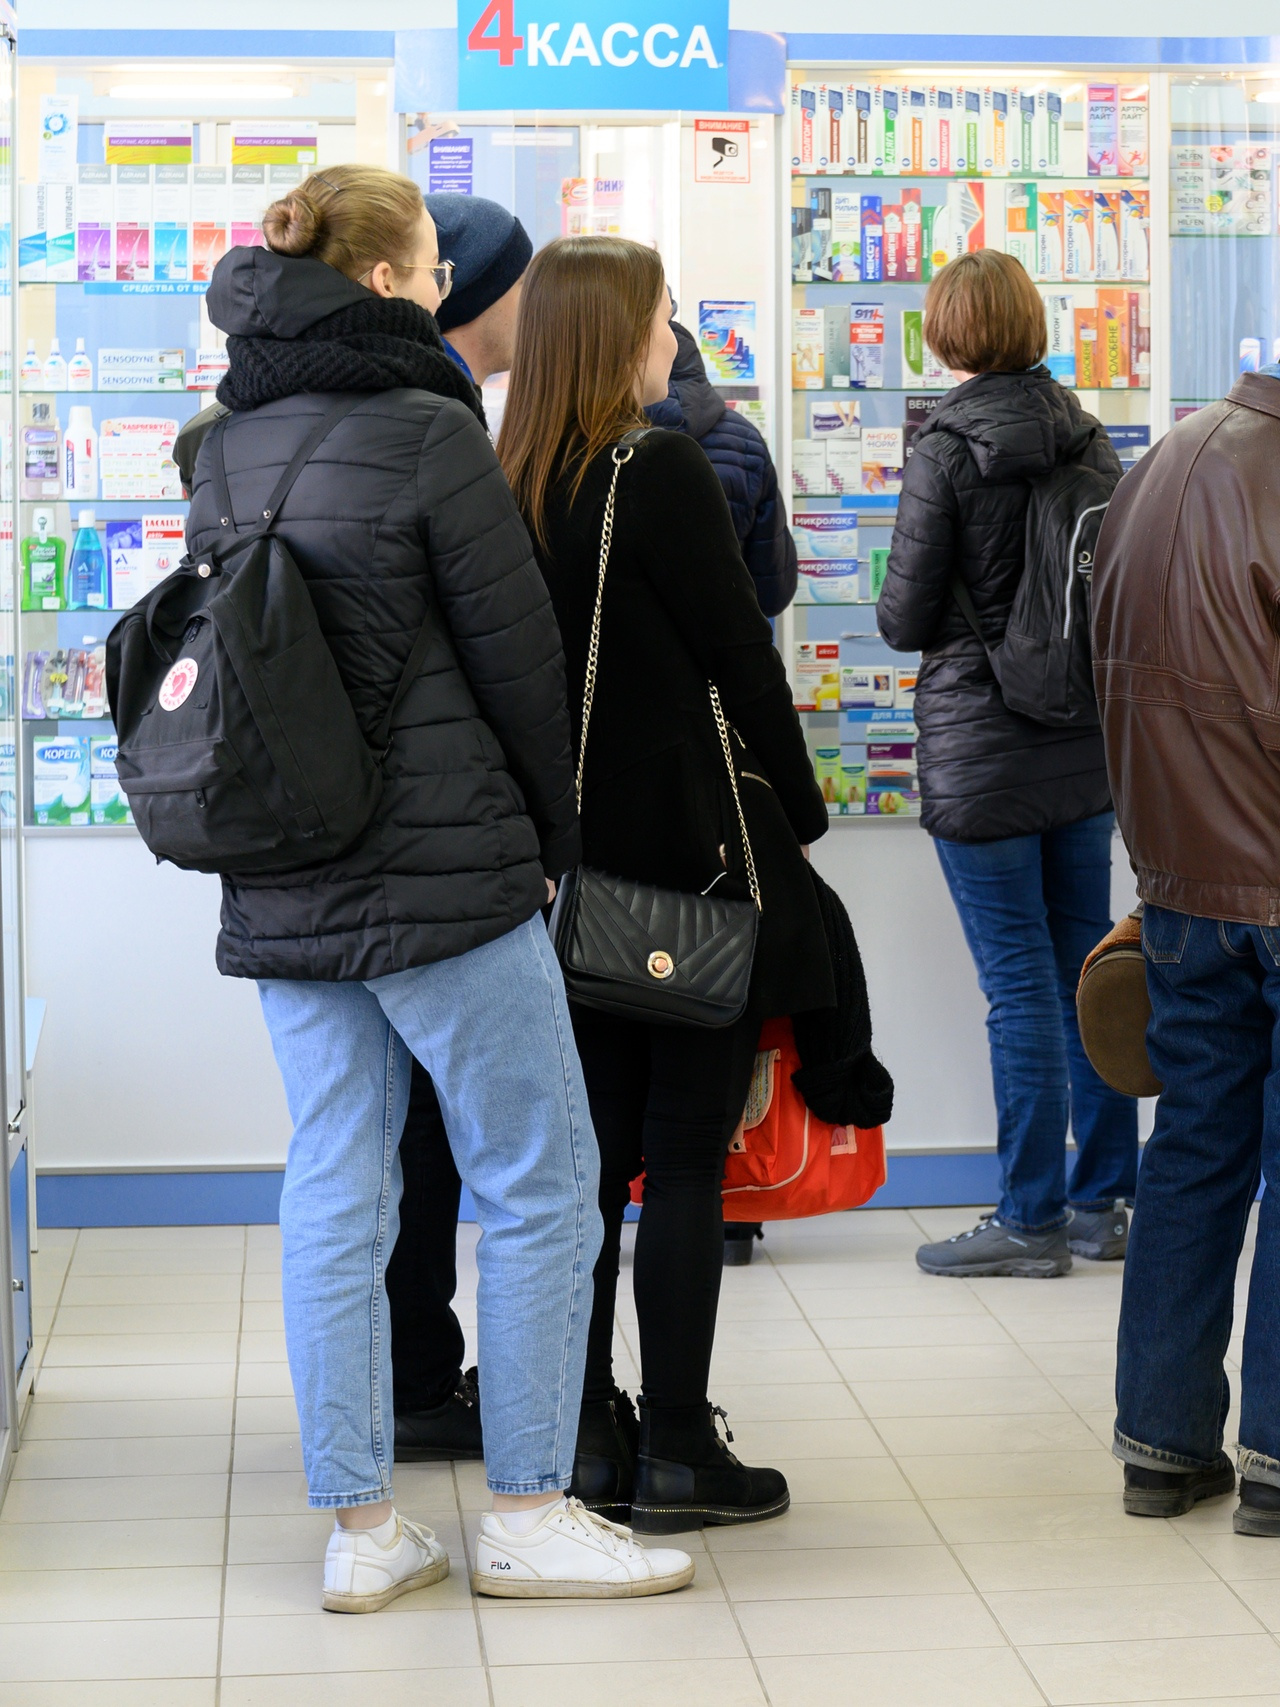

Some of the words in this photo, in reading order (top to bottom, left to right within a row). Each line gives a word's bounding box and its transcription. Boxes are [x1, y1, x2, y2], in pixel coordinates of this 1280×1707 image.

[468, 0, 525, 67] 4
[527, 22, 720, 69] КАССА
[698, 120, 747, 132] ВНИМАНИЕ!
[1066, 225, 1074, 275] Вольтарен
[866, 236, 874, 280] НЕКСТ
[122, 284, 174, 294] СРЕДСТВА
[177, 284, 190, 293] ОТ
[1052, 318, 1060, 352] Лиотон
[1108, 325, 1118, 378] ДОЛОБЕНЕ
[102, 356, 154, 364] SENSODYNE
[102, 376, 154, 384] SENSODYNE
[908, 400, 938, 410] ВЕНА
[794, 516, 855, 528] микролакс
[871, 712, 892, 720] ДЛЯ
[44, 750, 82, 760] КОРЕГА
[490, 1560, 512, 1570] FILA
